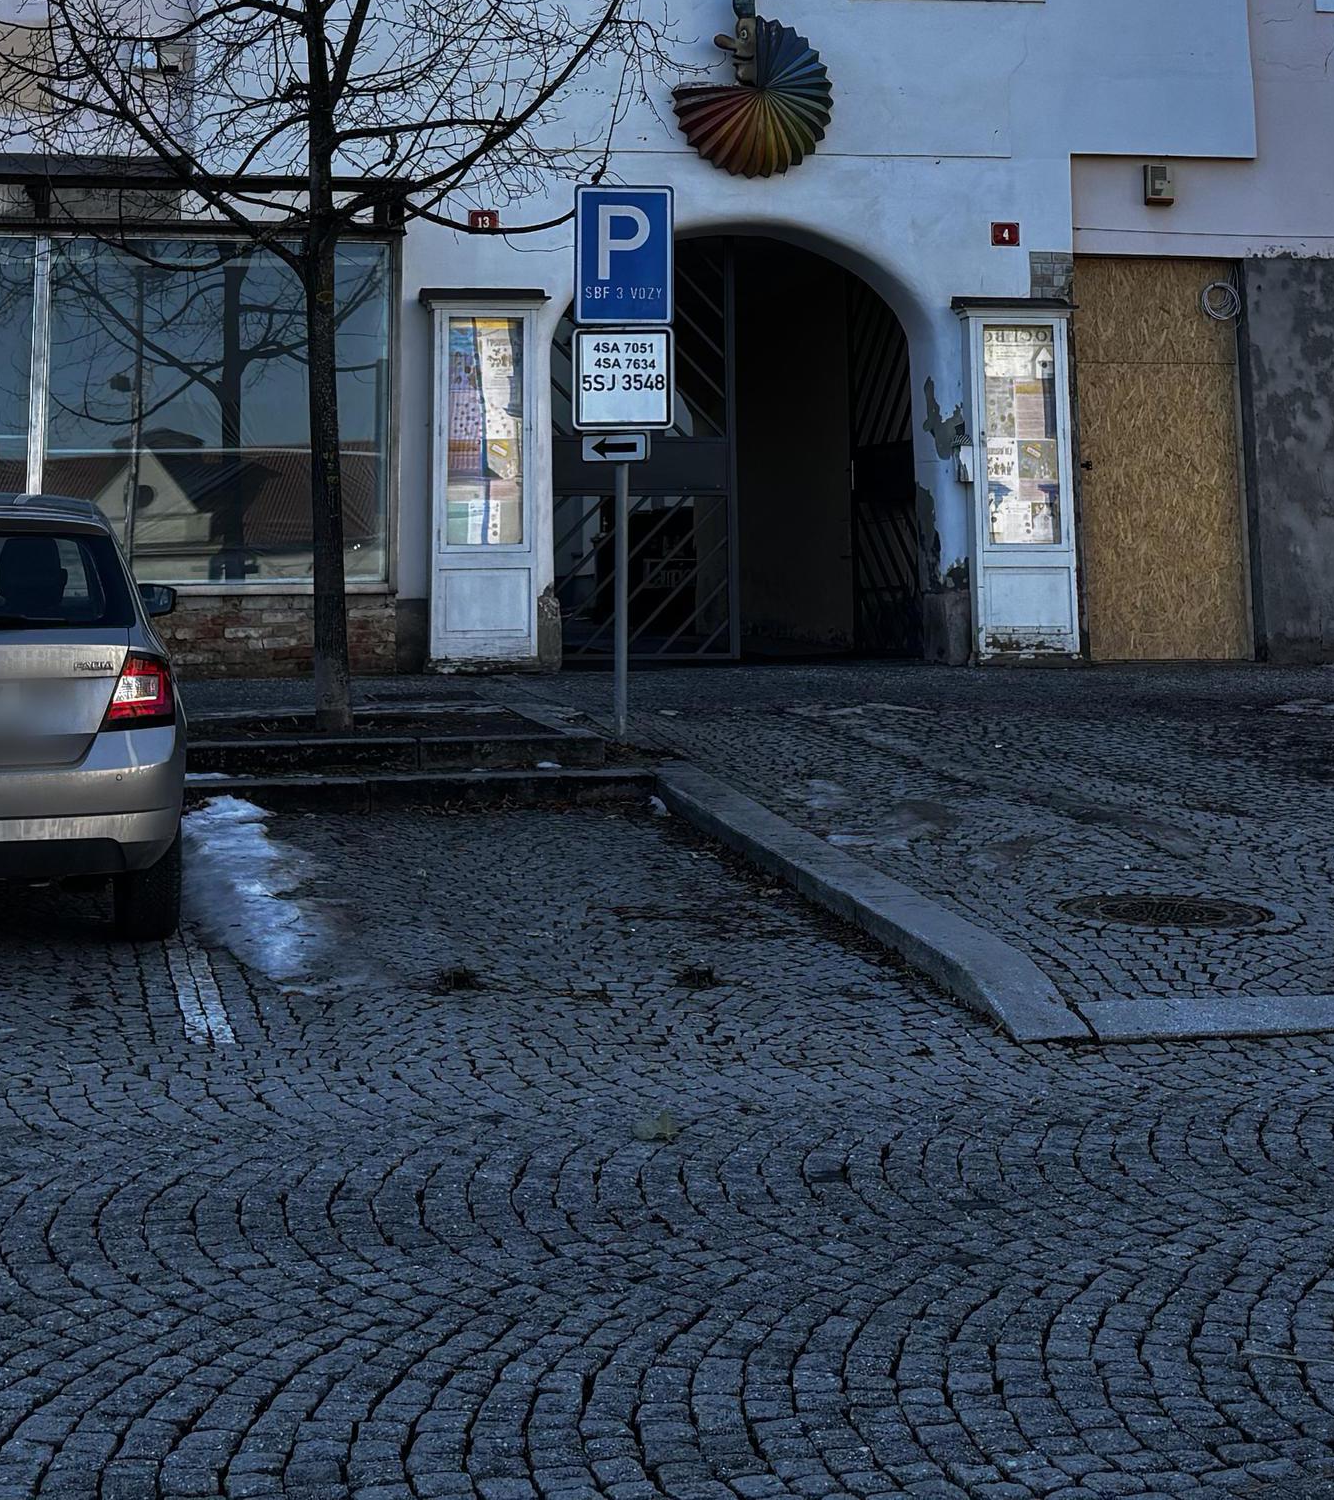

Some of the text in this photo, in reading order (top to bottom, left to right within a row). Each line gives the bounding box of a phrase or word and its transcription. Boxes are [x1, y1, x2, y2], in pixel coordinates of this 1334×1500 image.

[598, 204, 651, 280] P
[585, 286, 663, 300] SBF 3 VOZY
[593, 342, 654, 354] 4SA 7051
[594, 357, 656, 370] 4SA 7634
[582, 373, 665, 392] 5SJ 3548
